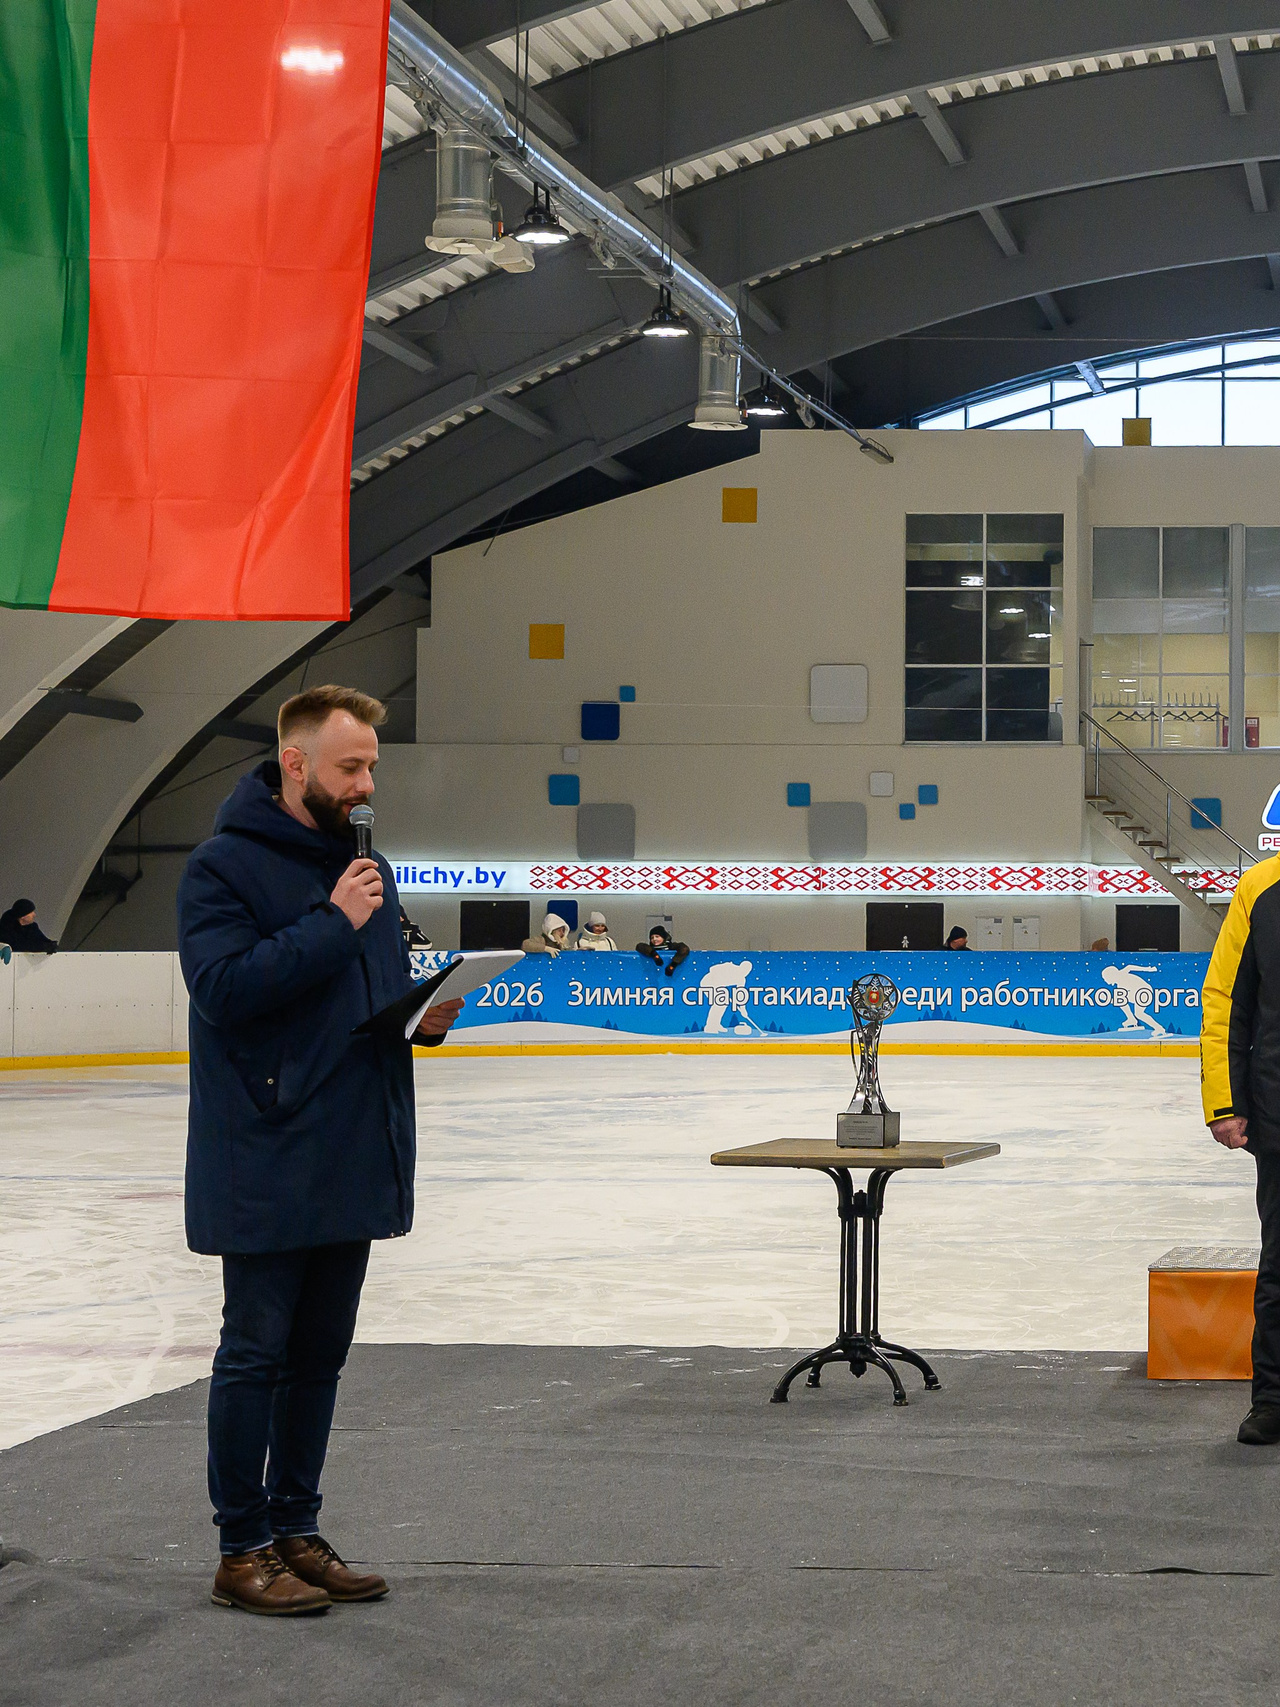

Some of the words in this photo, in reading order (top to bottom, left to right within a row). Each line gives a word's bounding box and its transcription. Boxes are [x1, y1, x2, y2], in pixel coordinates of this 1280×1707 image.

[395, 866, 507, 889] ilichy.by
[476, 981, 544, 1007] 2026
[567, 980, 674, 1006] Зимняя
[897, 985, 952, 1011] еди
[960, 980, 1129, 1013] работников
